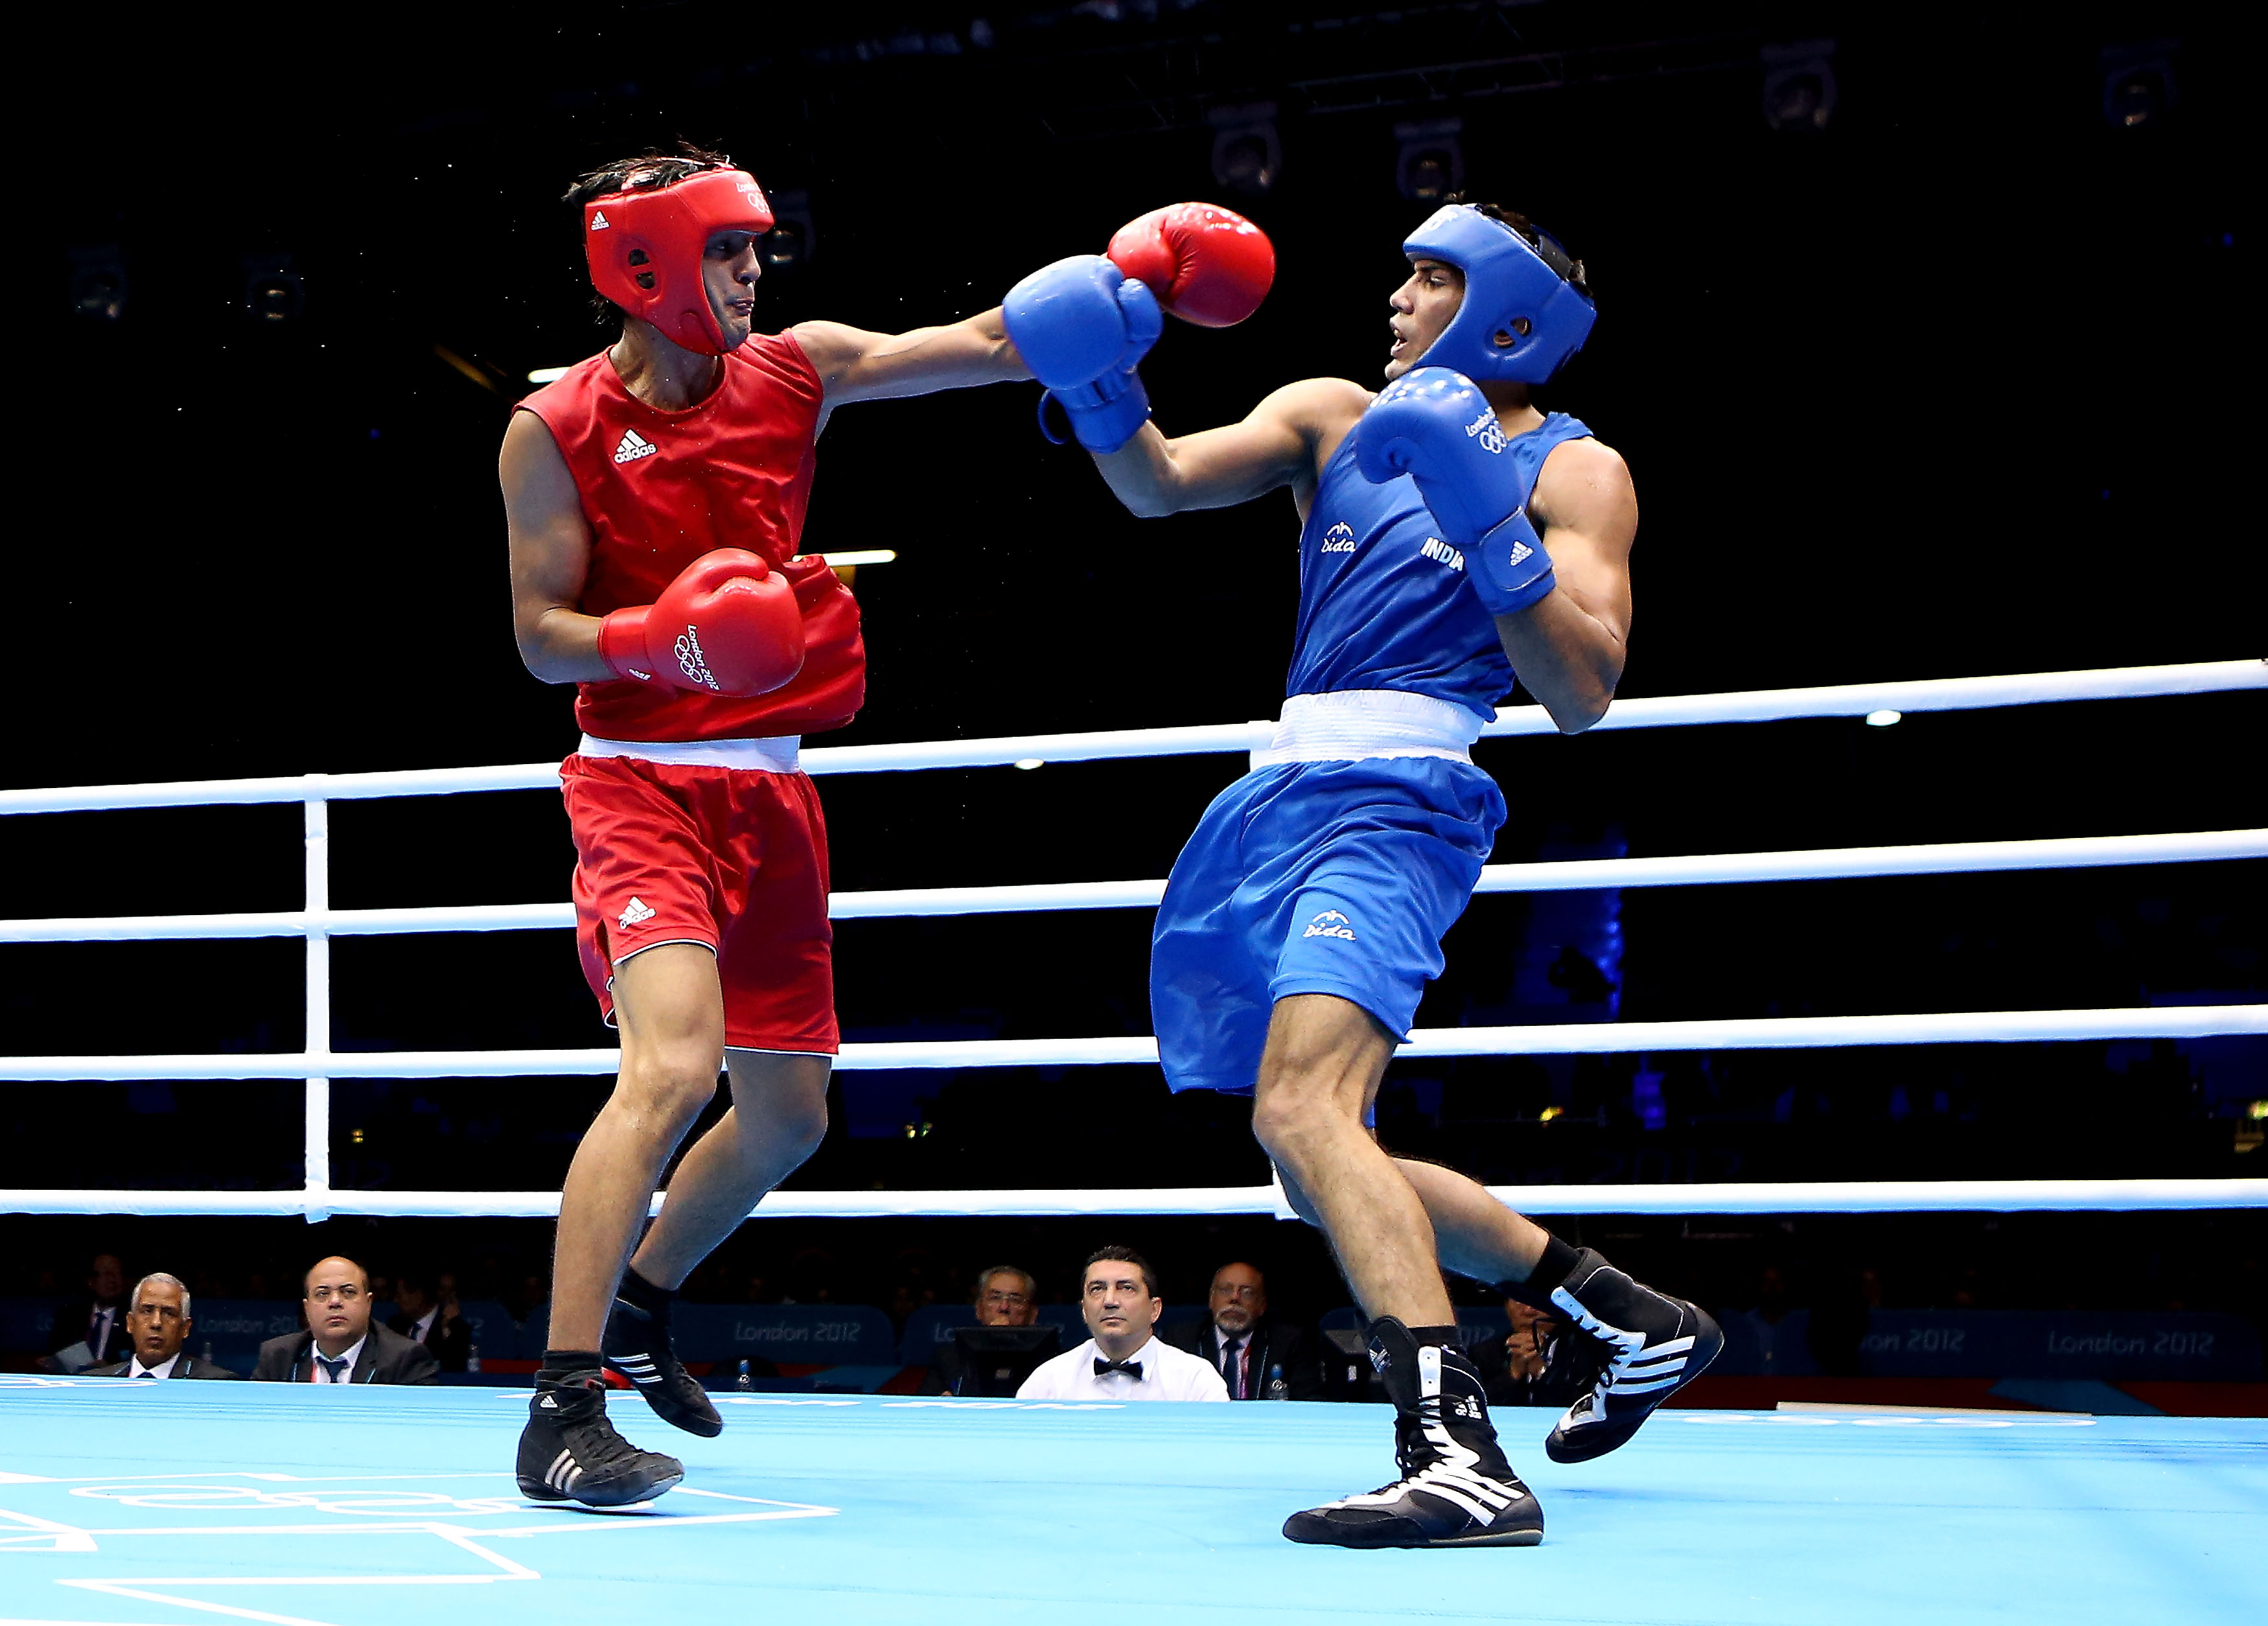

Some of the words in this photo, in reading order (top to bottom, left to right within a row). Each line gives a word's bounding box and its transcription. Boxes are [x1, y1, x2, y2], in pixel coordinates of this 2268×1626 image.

[614, 444, 656, 463] adidas
[688, 624, 705, 667] London
[701, 668, 720, 690] 2012
[269, 1314, 298, 1334] 201
[735, 1319, 809, 1341] London
[814, 1321, 861, 1342] 2012
[1906, 1327, 1965, 1353] 2012
[2048, 1329, 2146, 1354] London
[2153, 1329, 2215, 1356] 2012
